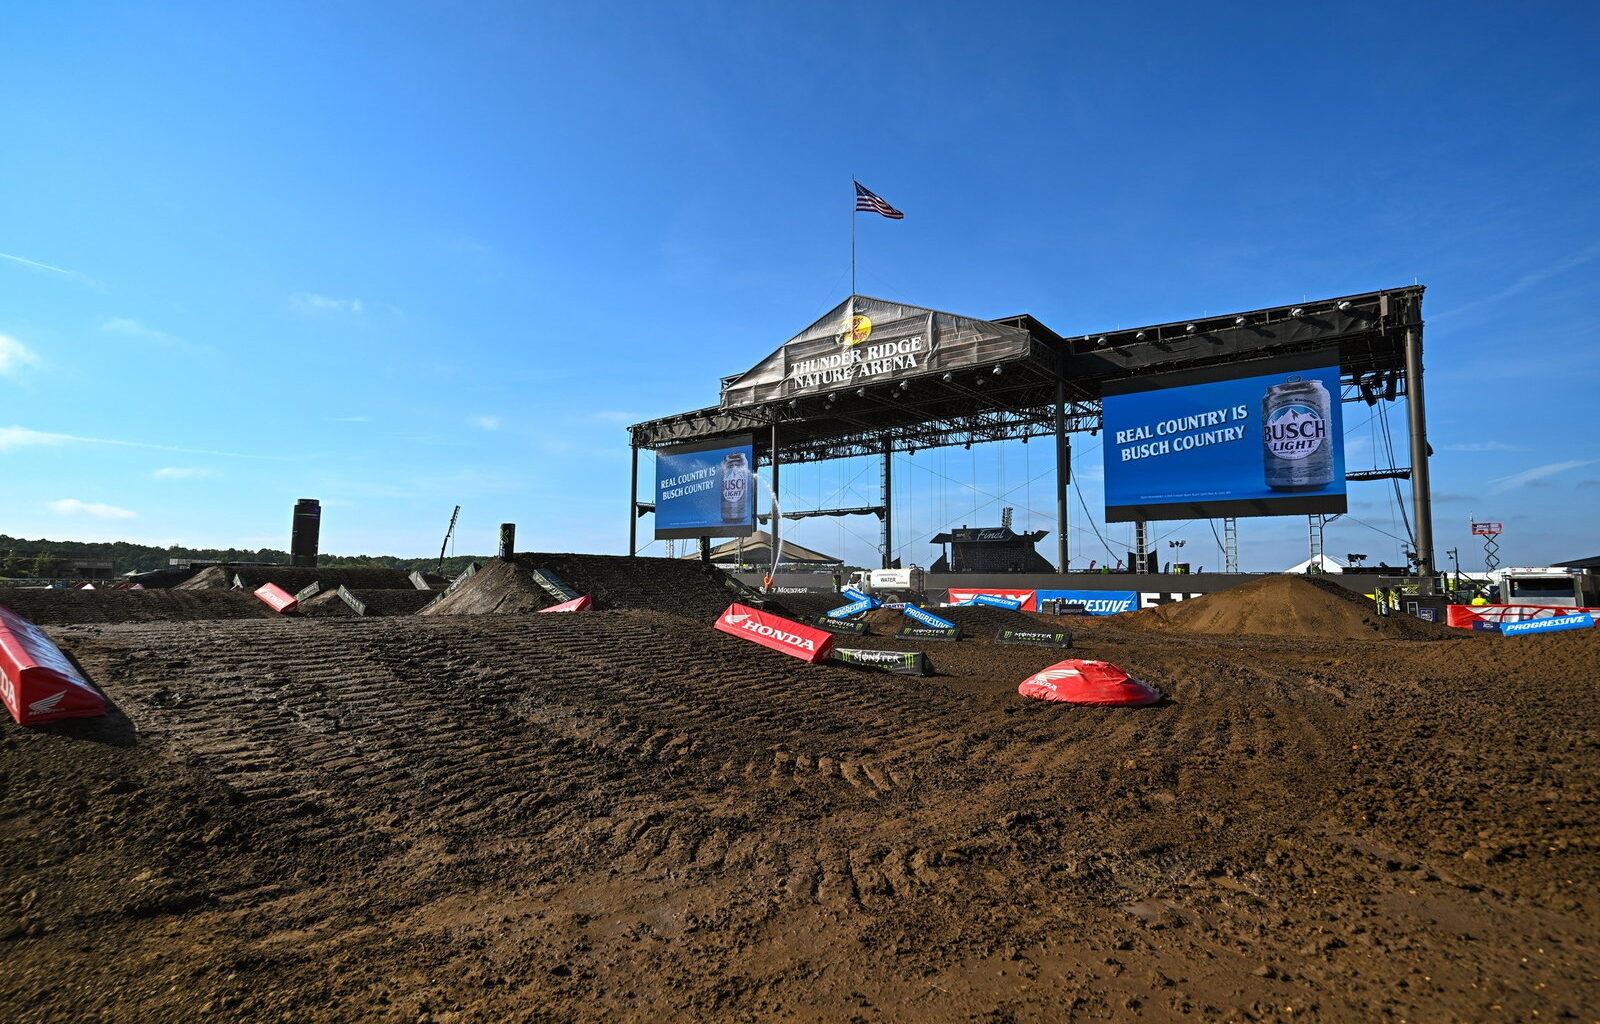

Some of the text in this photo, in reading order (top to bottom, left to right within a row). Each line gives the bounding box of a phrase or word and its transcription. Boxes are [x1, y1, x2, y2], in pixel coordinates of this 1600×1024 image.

[791, 337, 922, 374] THUNDER RIDGE
[794, 354, 917, 389] NATURE ARENA
[1116, 405, 1248, 444] REAL COUNTRY IS
[1264, 420, 1326, 442] BUSCH
[1121, 426, 1246, 462] BUSCH COUNTRY
[1273, 440, 1314, 451] LIGHT
[661, 466, 716, 489] REAL COUNTRY IS
[663, 480, 714, 500] BUSCH COUNTRY
[977, 529, 1006, 542] Final
[1506, 615, 1586, 631] PROGRESSIVE
[742, 620, 815, 651] HONDA
